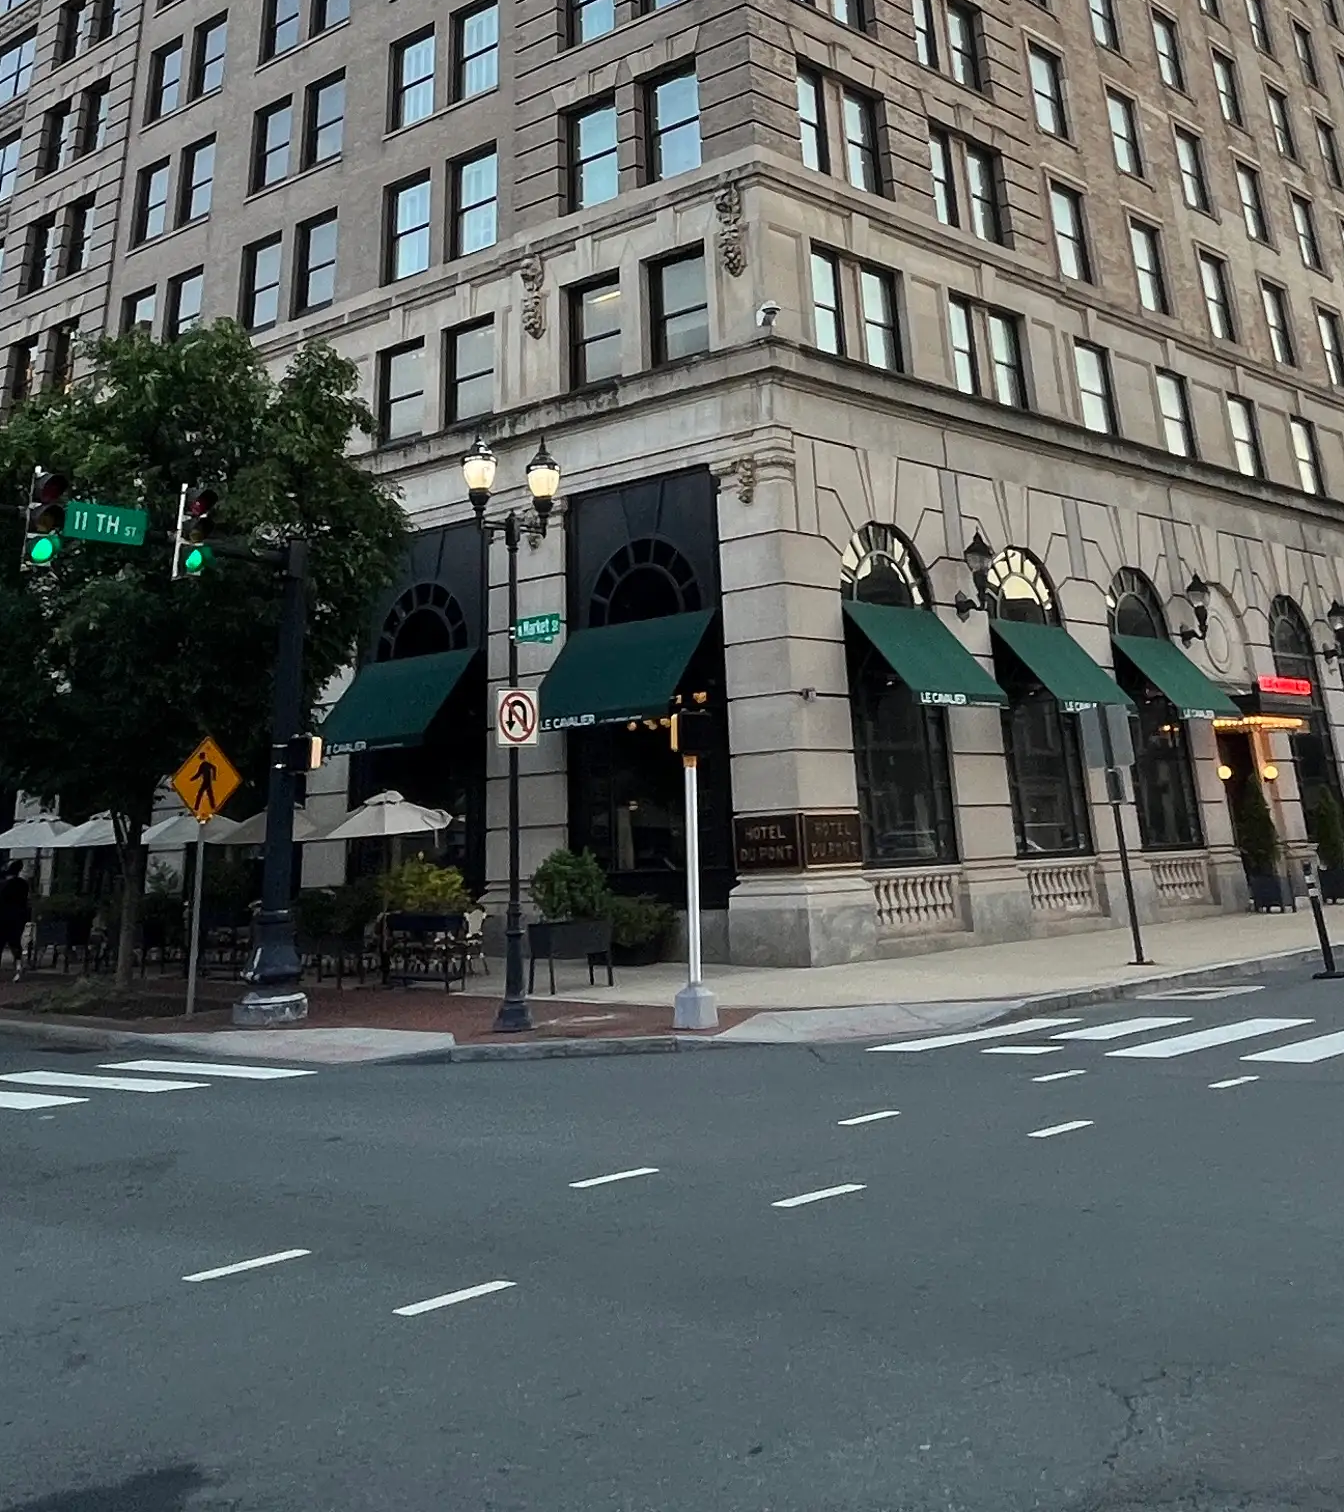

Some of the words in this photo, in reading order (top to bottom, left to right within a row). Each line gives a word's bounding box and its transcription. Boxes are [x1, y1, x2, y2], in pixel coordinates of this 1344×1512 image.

[74, 511, 88, 530] 11
[96, 513, 120, 535] TH
[124, 526, 137, 537] ST
[523, 618, 550, 636] Market
[920, 691, 932, 704] LE
[1064, 701, 1074, 712] LE
[540, 719, 552, 731] LE
[745, 825, 787, 841] HOTEL
